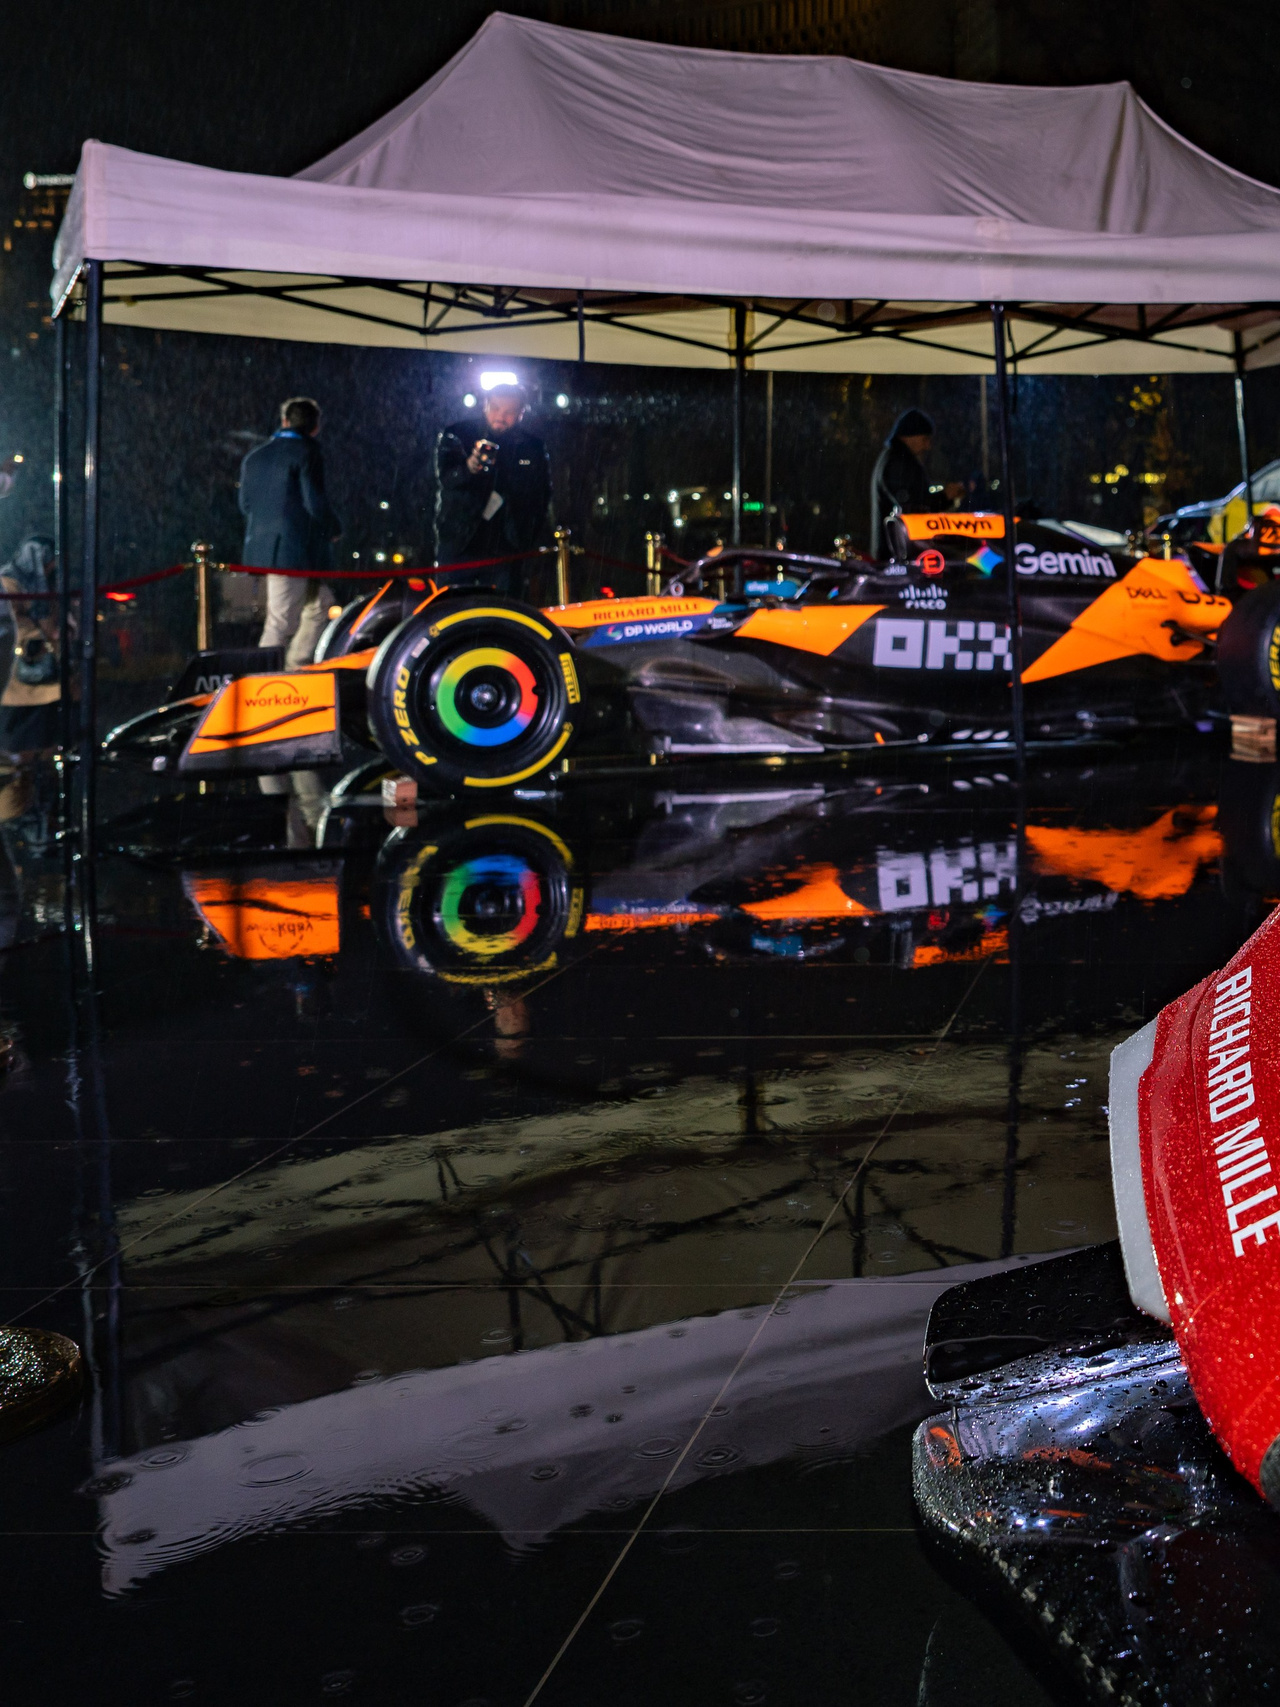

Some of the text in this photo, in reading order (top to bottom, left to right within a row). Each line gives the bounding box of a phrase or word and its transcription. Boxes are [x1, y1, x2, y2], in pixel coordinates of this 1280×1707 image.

[926, 517, 992, 534] allwyn
[1015, 543, 1118, 578] Gemini
[593, 602, 703, 622] RICHARD MILLE
[624, 625, 644, 638] DP
[644, 620, 694, 635] WORLD
[873, 618, 1022, 671] OKX
[245, 694, 309, 708] workday
[393, 666, 438, 766] P ZERO
[1208, 965, 1256, 1123] RICHARD
